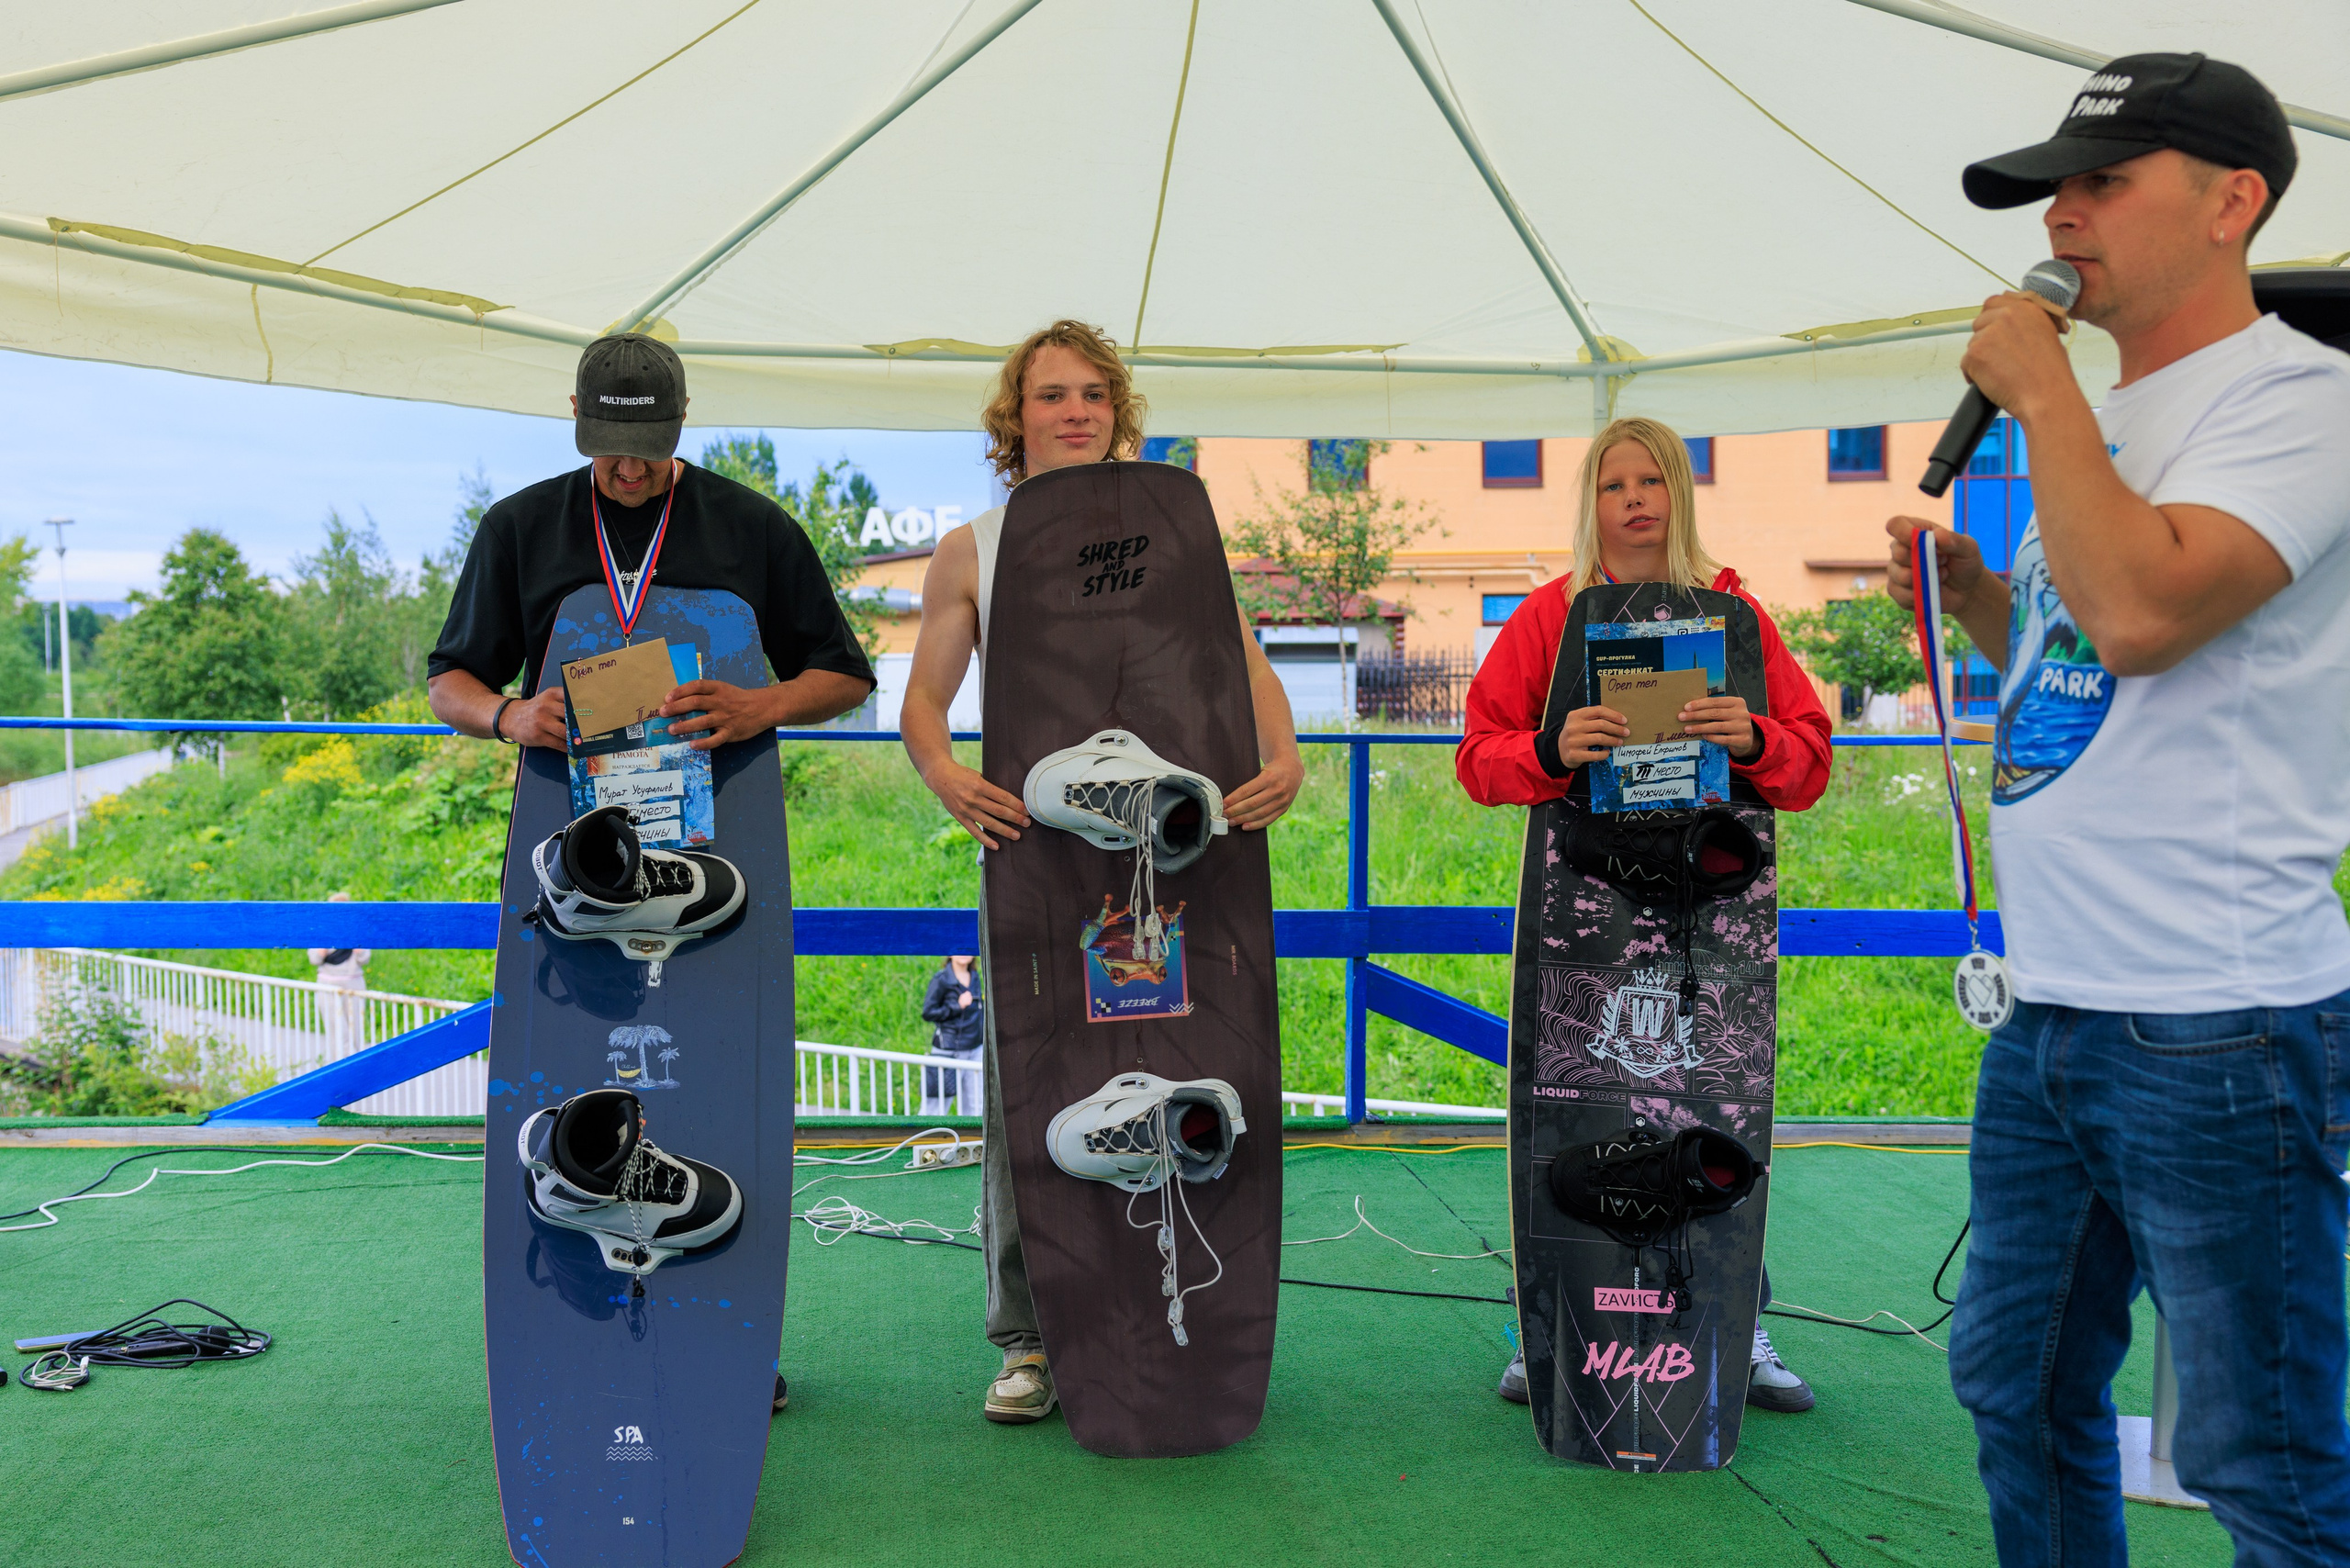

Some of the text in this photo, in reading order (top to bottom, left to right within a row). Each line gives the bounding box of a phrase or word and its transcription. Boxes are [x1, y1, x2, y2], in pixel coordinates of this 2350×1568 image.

[2070, 95, 2125, 118] PARK
[599, 395, 655, 407] MULTIRIDERS
[1077, 535, 1149, 567] SHRED
[1102, 560, 1125, 574] AND
[1082, 566, 1147, 598] STYLE
[599, 659, 617, 671] men
[1596, 666, 1654, 677] СЕРТИФИКАТ
[1607, 678, 1658, 693] Open men
[2039, 666, 2105, 700] PARK
[611, 750, 649, 760] ГРАМОТА
[599, 787, 628, 804] Мурат
[635, 827, 671, 841] чины
[1117, 996, 1161, 1009] BREEZE
[1581, 1340, 1695, 1383] MLAB
[613, 1426, 644, 1445] SPA
[622, 1517, 635, 1526] 154
